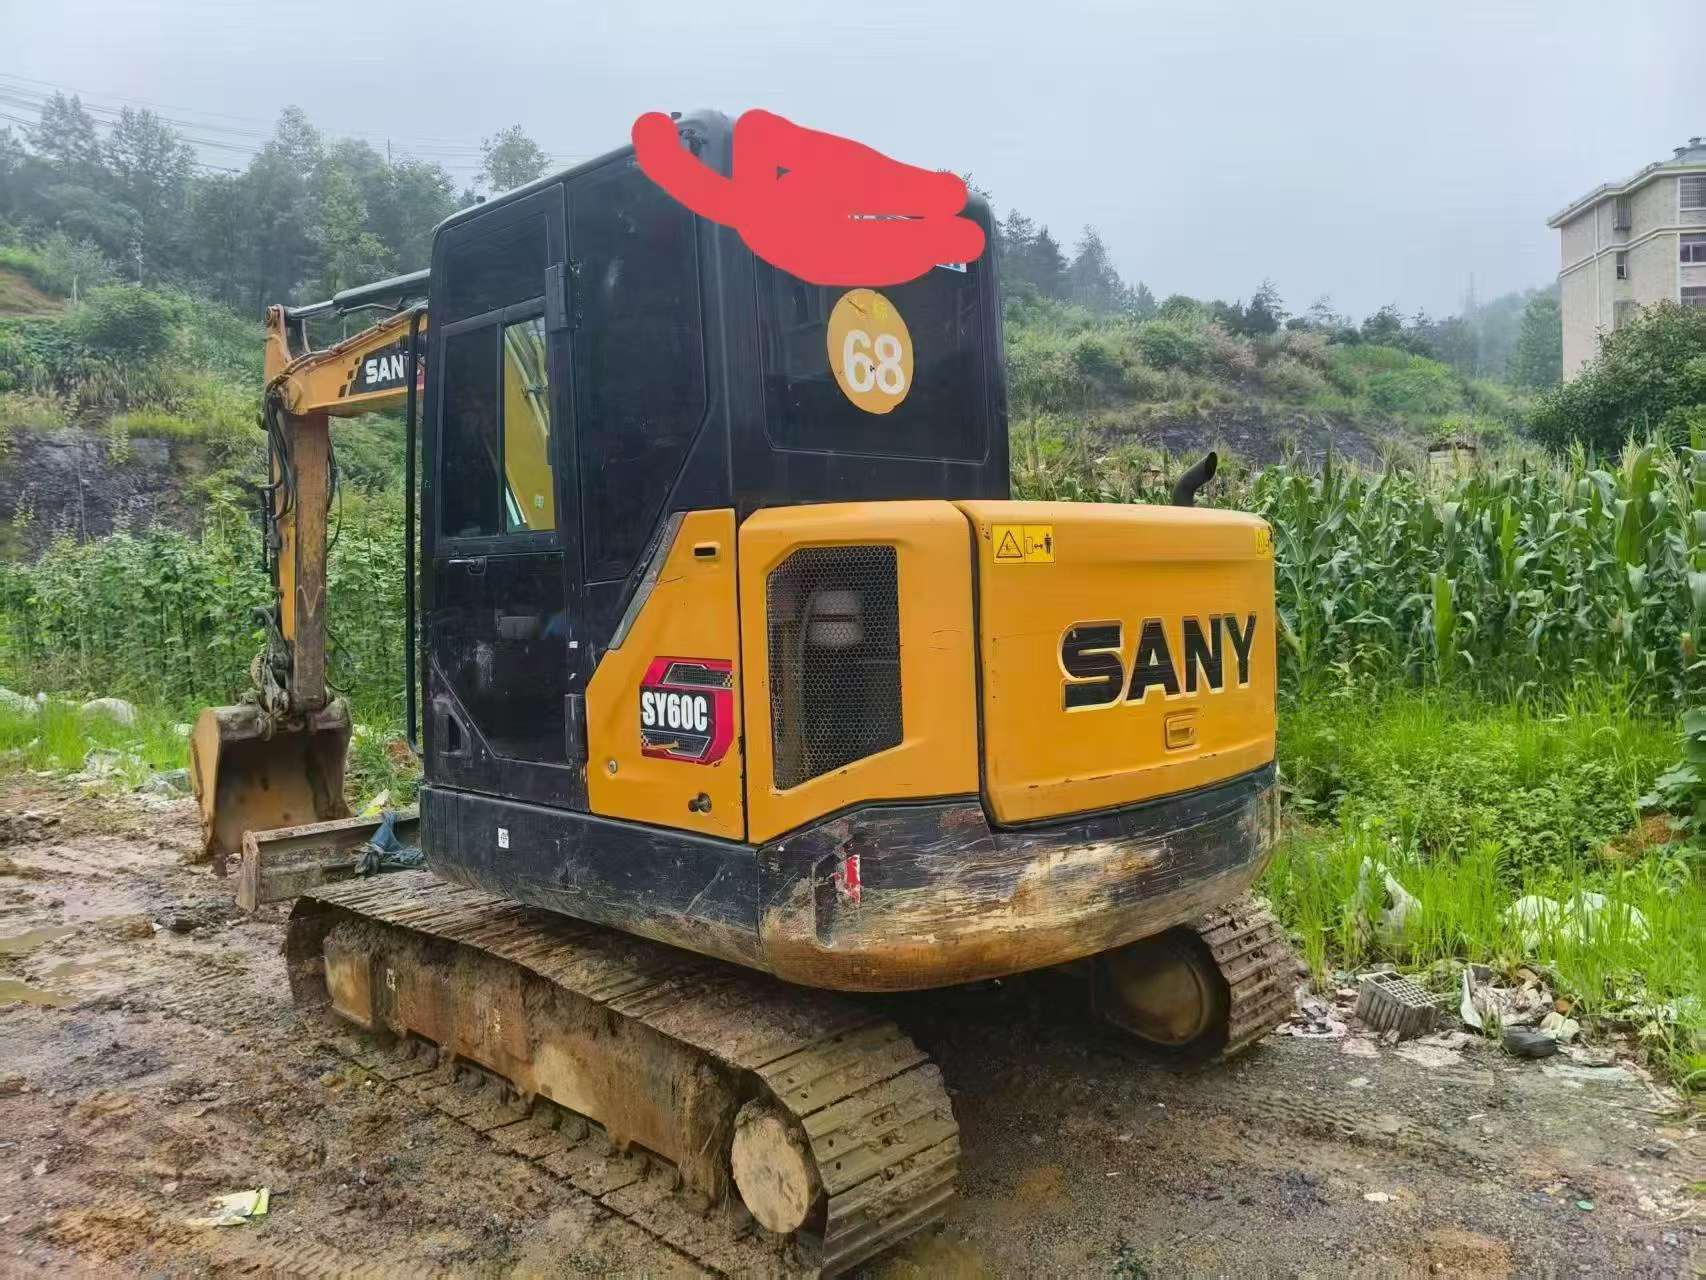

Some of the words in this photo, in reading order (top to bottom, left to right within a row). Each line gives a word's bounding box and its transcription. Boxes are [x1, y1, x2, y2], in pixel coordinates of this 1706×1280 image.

[365, 351, 409, 384] SAN
[843, 329, 906, 395] 68
[1057, 612, 1257, 712] SANY
[641, 690, 708, 732] SY60C
